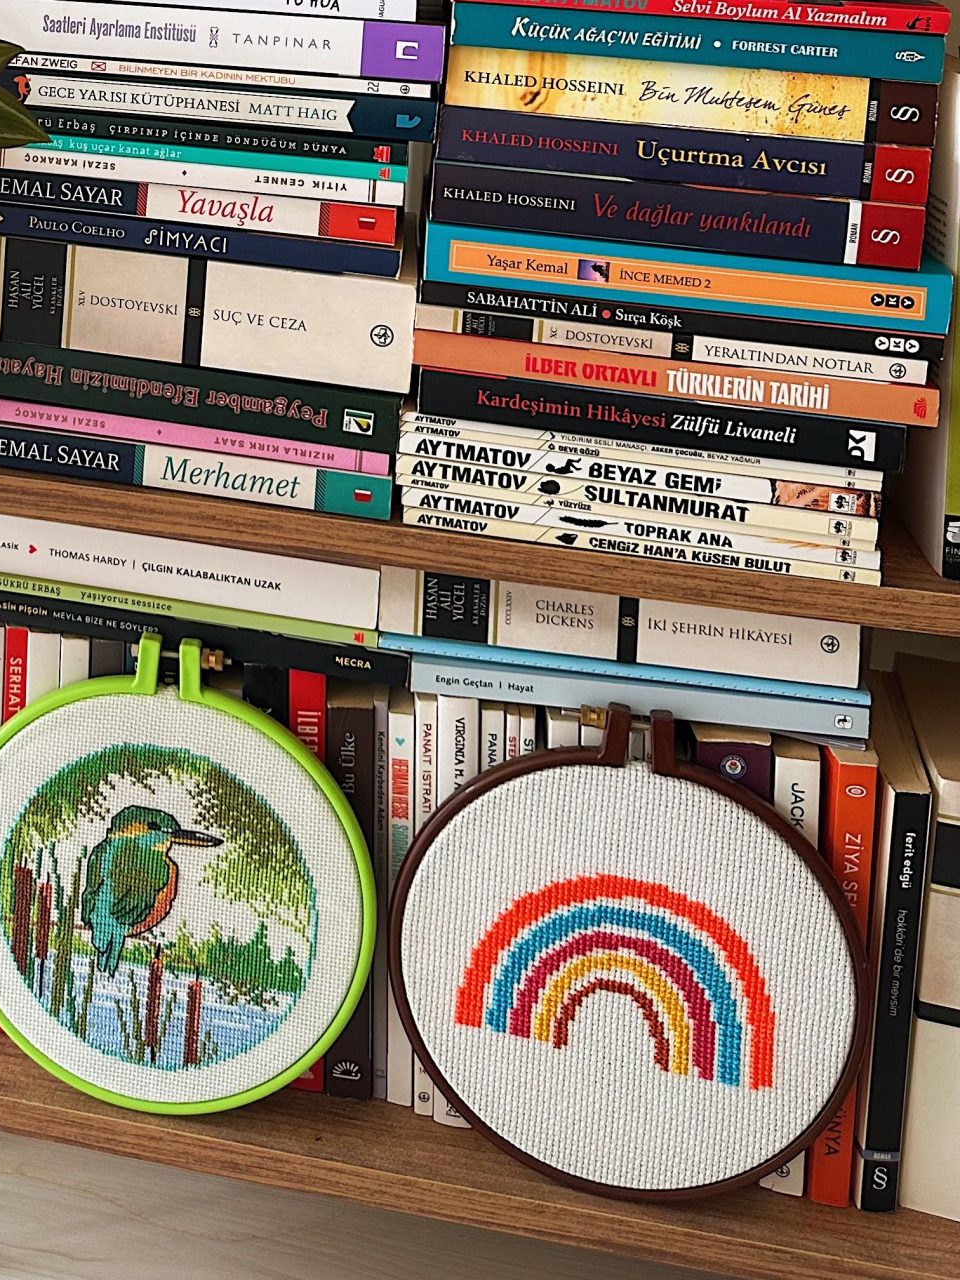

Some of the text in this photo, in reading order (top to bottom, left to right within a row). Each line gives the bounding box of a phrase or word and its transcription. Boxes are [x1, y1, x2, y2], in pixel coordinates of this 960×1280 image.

[673, 0, 887, 26] Selvi Boylum Al Yazmalım
[43, 14, 331, 50] Saatleri Ayarlama Enstitüsü TANPINAR
[574, 27, 838, 57] AĞAÇ'IN EĞİTİMİ FORREST CARTER
[119, 64, 295, 84] BİLİNMEYEN BİR KADININ MEKTUBU
[38, 85, 338, 121] GECE YARISI KÜTÜPHANESİ MATT HAIG
[464, 71, 850, 120] KHALED HOSSEINI Bin Muhteşem Güneş
[69, 140, 182, 159] kuş uçar kanat ağlar
[109, 125, 347, 155] ÇIRPINIP İÇİNDE DÖNDÜĞÜM DÜNYA
[462, 129, 826, 175] KHALED HOSSEINI Uçurtma Avcısı
[24, 153, 347, 191] YİTİK CENNET SEZAİ KARAKOÇ
[61, 182, 123, 206] SAYAR
[178, 189, 274, 226] Yavaşla
[443, 187, 811, 239] KHALED HOSSEINI Ve dağlar yankılandı
[144, 226, 227, 253] SİMYACI
[487, 254, 711, 289] Yaşar Kemal İNCE MEMED 2
[90, 295, 178, 316] DOSTOYEVSKİ
[213, 309, 307, 331] SUÇ VE CEZA
[467, 291, 682, 328] SABAHATTİN ALİ Sırça Köşk
[565, 330, 652, 349] DOSTOYEVSKİ
[705, 344, 873, 374] YERALTINDAN NOTLAR
[70, 368, 200, 407] Efendimizin
[525, 353, 829, 410] İLBER ORTAYLI TÜRKLERİN TARİHİ
[206, 390, 328, 428] Peygamber
[477, 390, 797, 444] Kardeşimin Hikâyesi Zülfü Livaneli
[58, 445, 120, 471] SAYAR
[160, 456, 300, 499] Merhamet
[416, 438, 656, 486] AYTMATOV BEYAZ
[412, 460, 751, 523] AYTMATOV SULTANMURAT
[419, 494, 733, 548] AYTMATOV TOPRAK ANA
[417, 514, 792, 573] AYTMATOV KÜSEN BULUT
[49, 548, 282, 591] THOMAS HARDY ÇILGIN KALABALIKTAN UZAK
[32, 583, 172, 611] ERBAŞ yaşıyoruz sessizce
[536, 600, 594, 615] CHARLES
[536, 613, 594, 629] DICKENS
[648, 618, 793, 645] İKİ ŞEHRİN HİKÂYESİ
[435, 675, 534, 693] Engin Geçtan Hayat
[454, 718, 465, 767] VIRGINIA
[422, 723, 431, 813] PANAIT ISTRATI
[843, 832, 864, 874] ZİYA
[900, 832, 916, 889] ferit edgü
